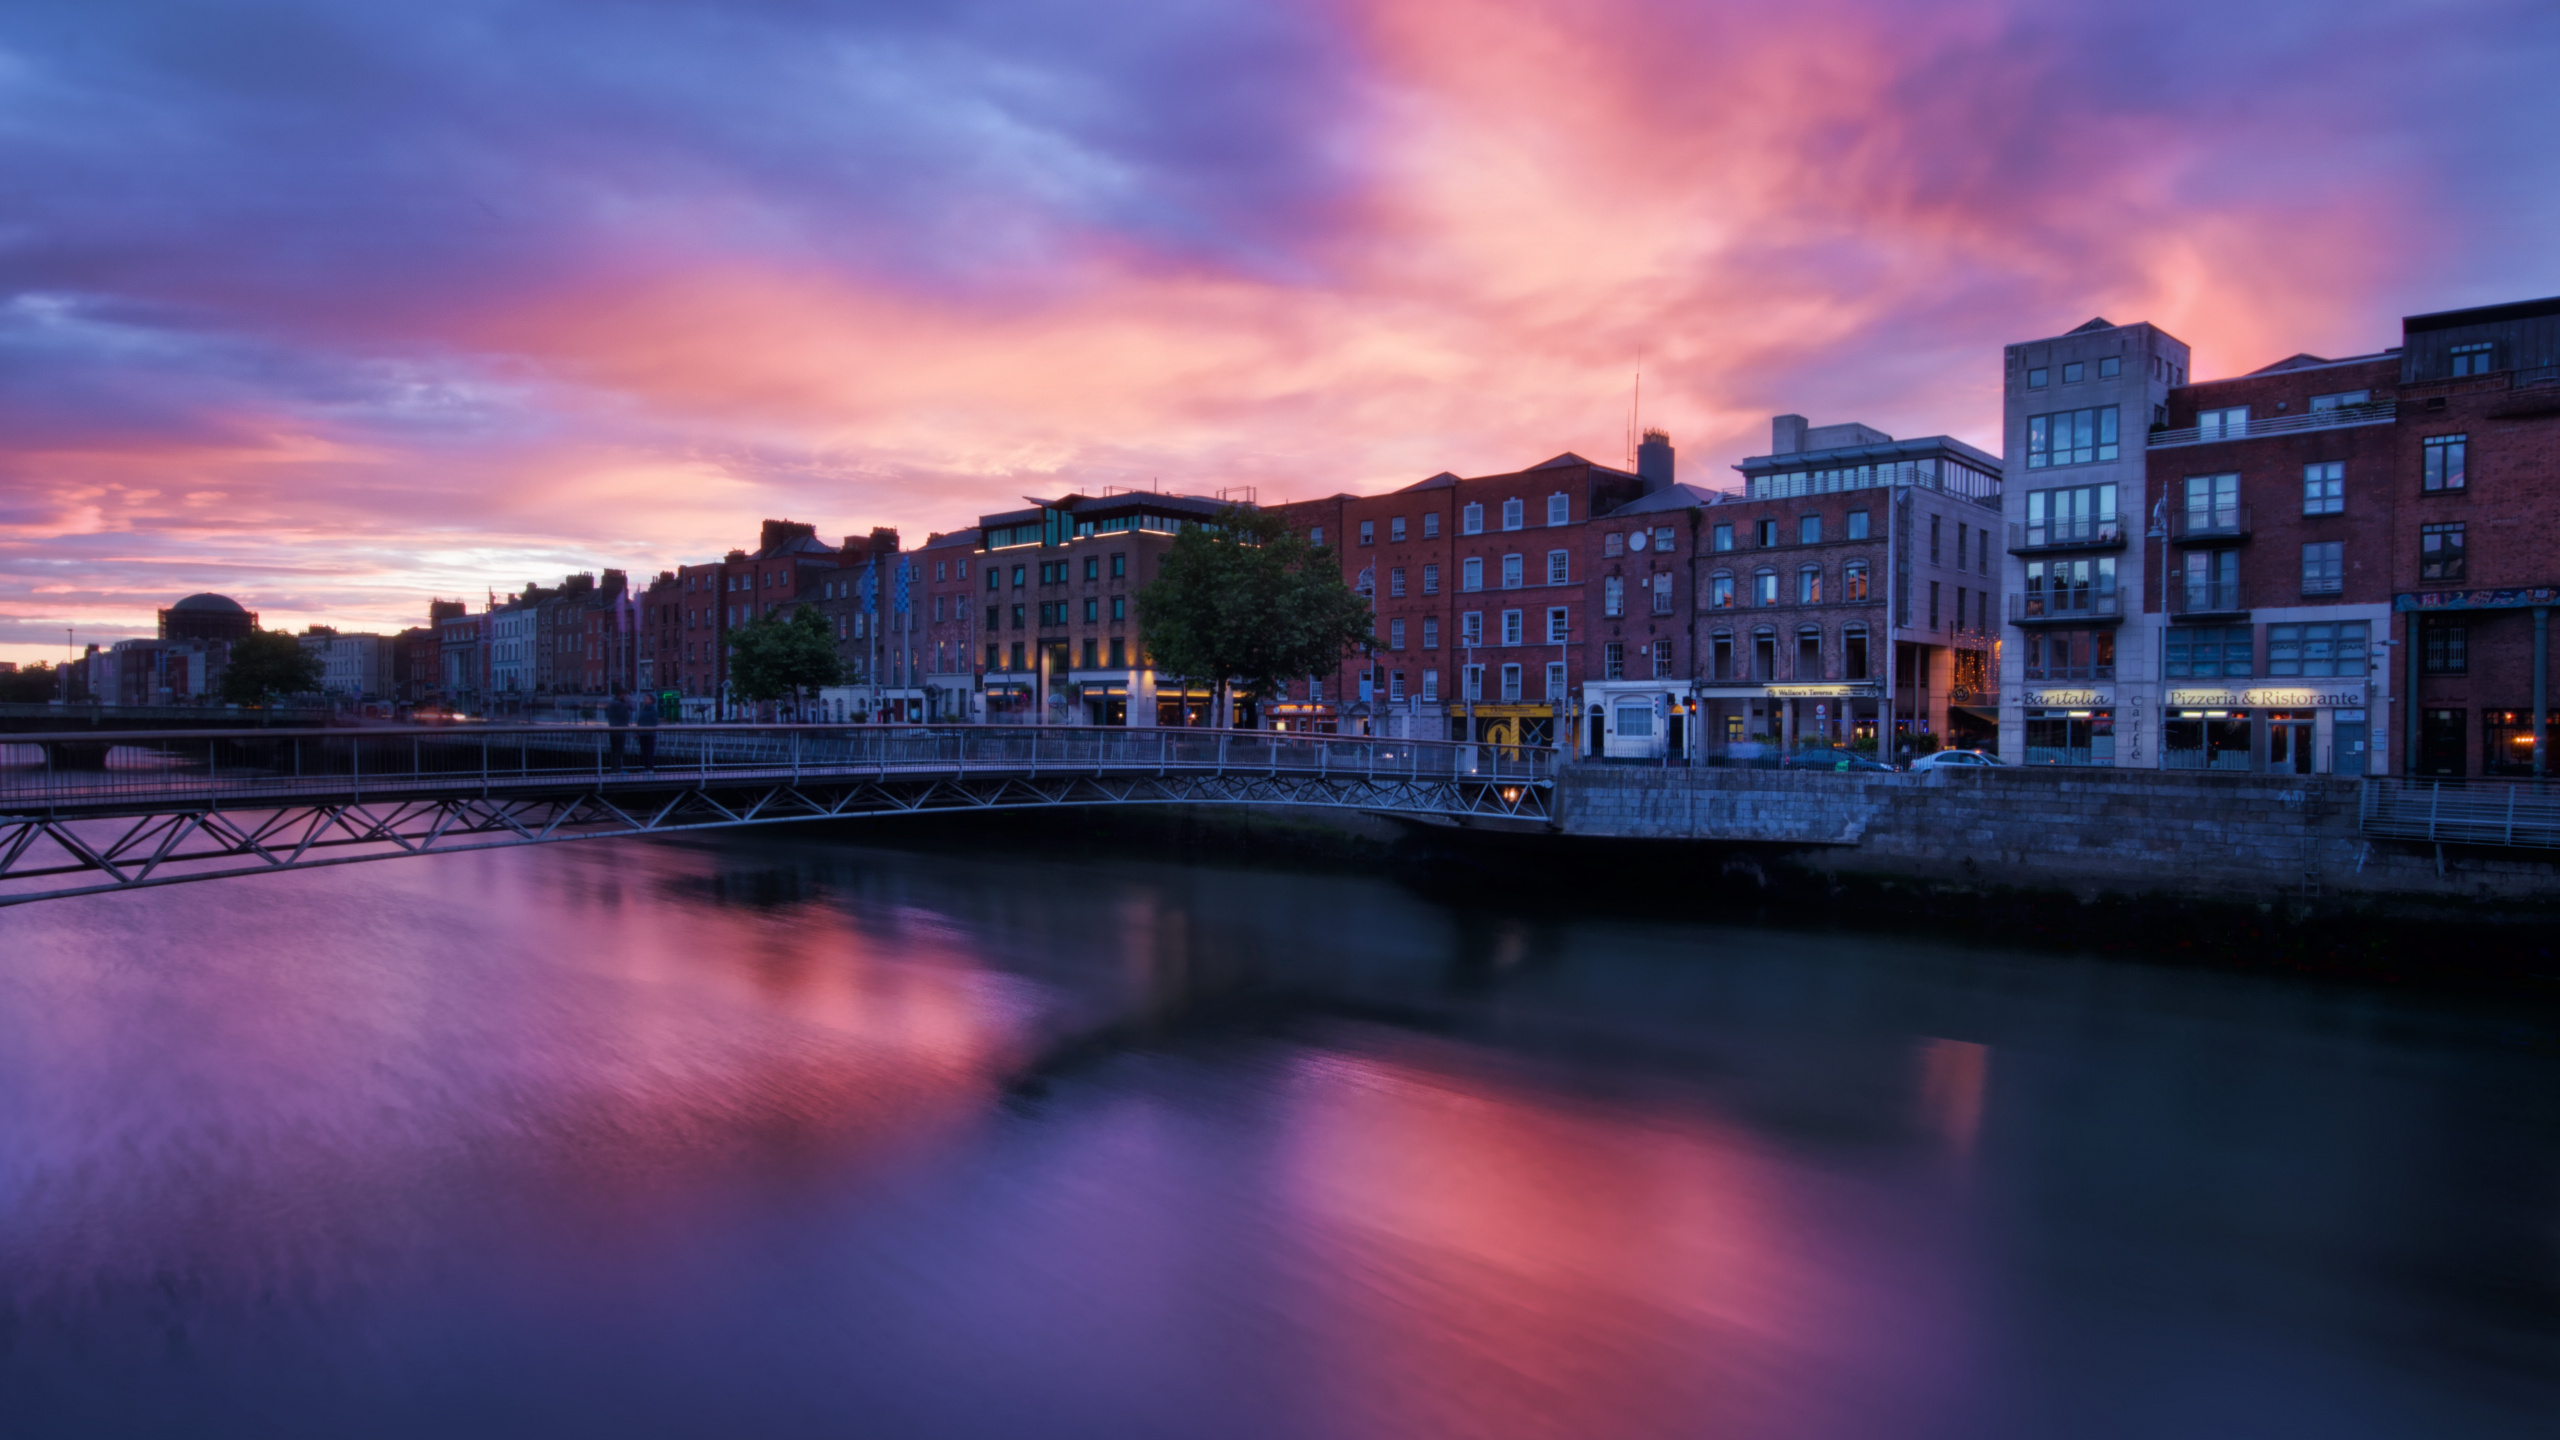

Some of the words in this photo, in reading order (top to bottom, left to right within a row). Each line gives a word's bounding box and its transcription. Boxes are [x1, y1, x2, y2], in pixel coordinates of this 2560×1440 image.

[2023, 691, 2110, 706] Baritalia
[2170, 691, 2236, 706] Pizzeria
[2241, 691, 2257, 705] &
[2261, 691, 2359, 706] Ristorante
[2130, 695, 2143, 761] Caffé
